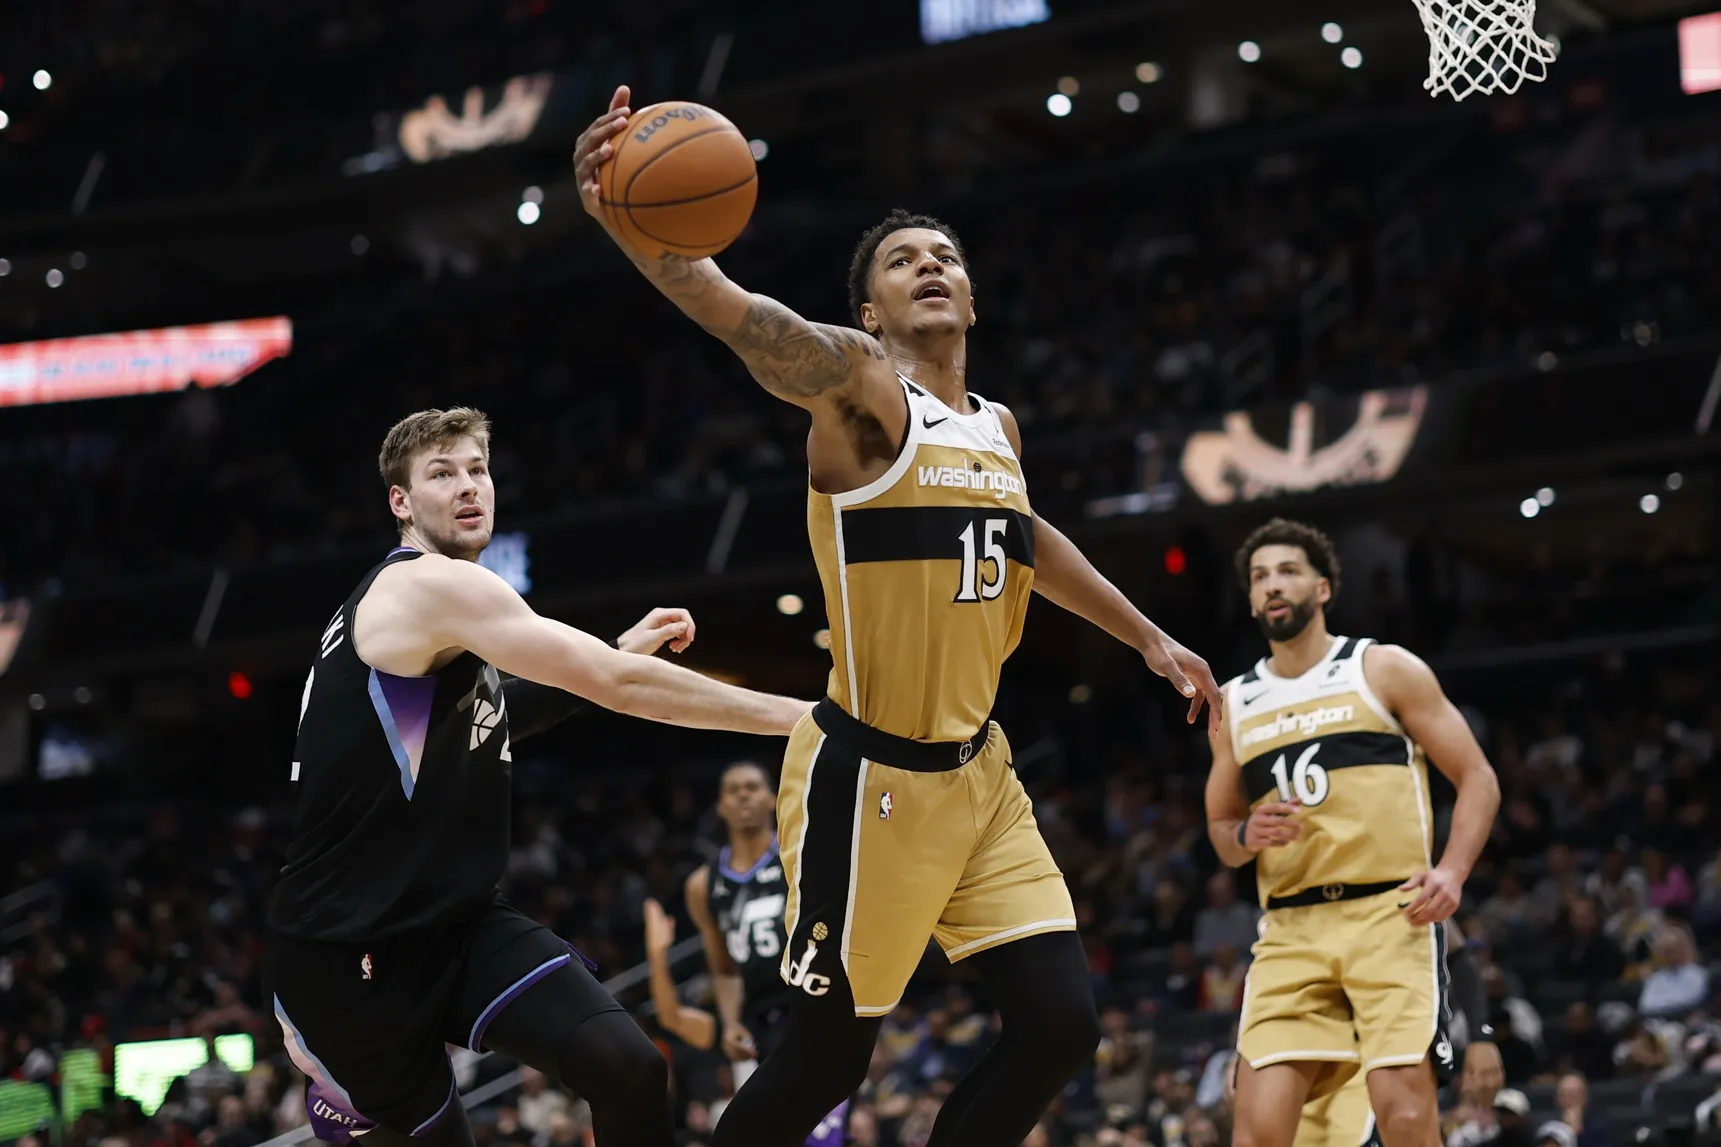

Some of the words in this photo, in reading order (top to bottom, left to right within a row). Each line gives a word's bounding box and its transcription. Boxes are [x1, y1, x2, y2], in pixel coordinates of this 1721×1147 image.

[634, 106, 706, 143] ilson
[918, 457, 1024, 499] washington
[954, 518, 1008, 602] 15
[1270, 742, 1329, 807] 16
[313, 1099, 358, 1128] UTAH
